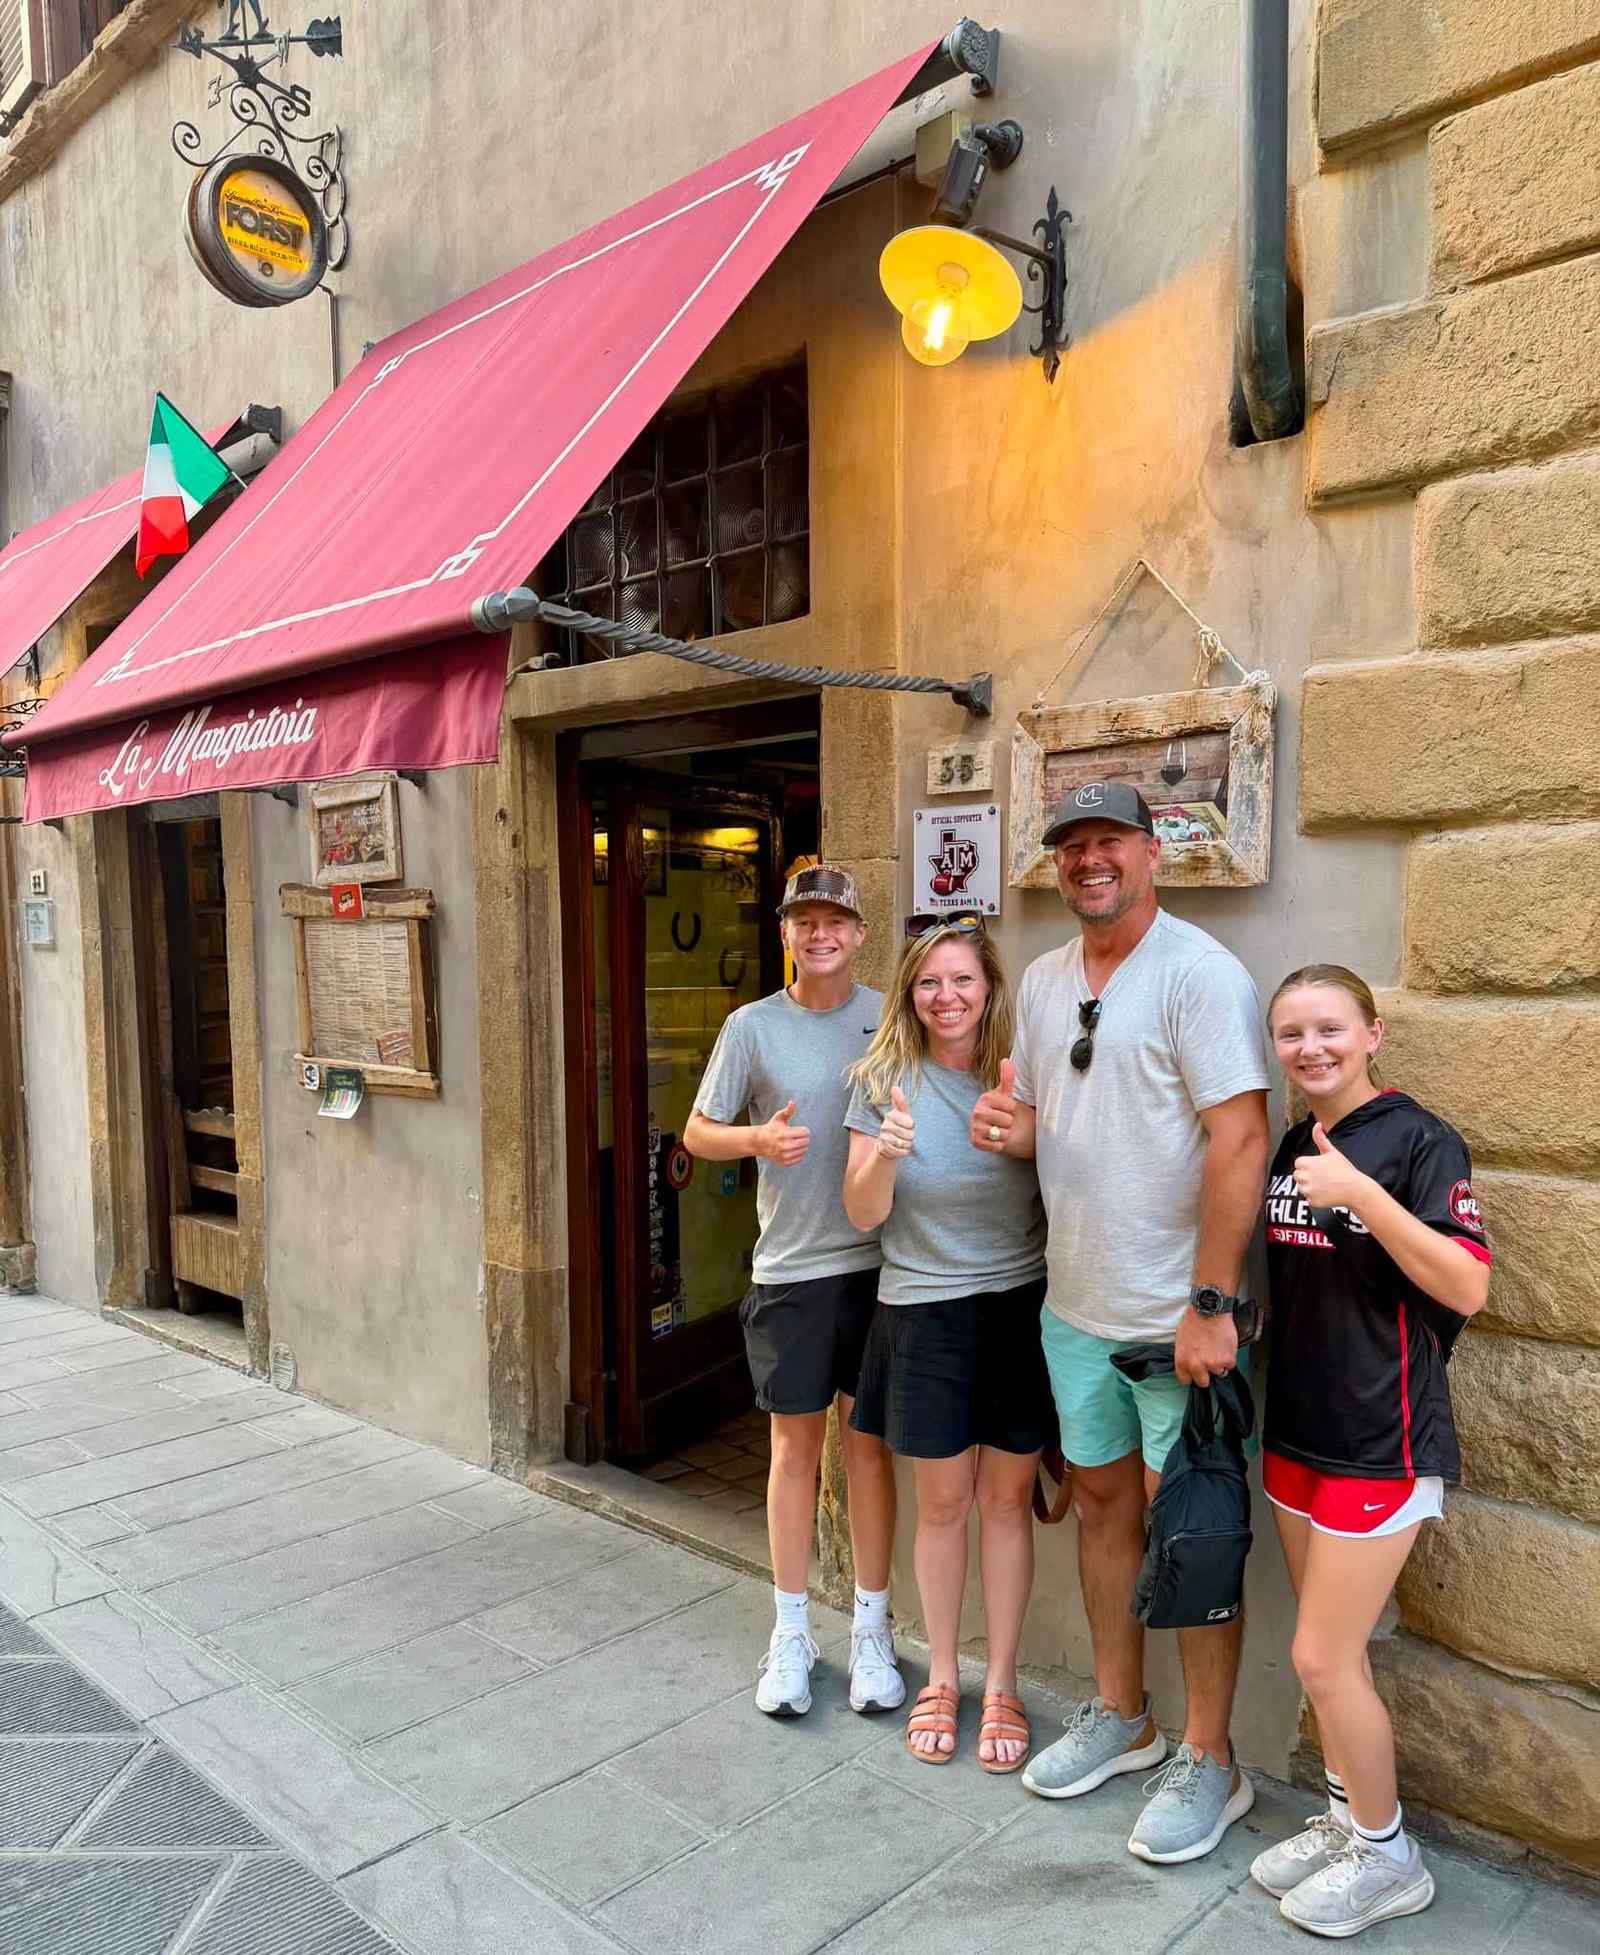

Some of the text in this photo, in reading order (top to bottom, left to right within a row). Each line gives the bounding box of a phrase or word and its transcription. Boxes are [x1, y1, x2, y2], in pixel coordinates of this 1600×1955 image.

[226, 201, 305, 249] FORST
[99, 697, 318, 796] La Mangiatoia
[931, 813, 982, 825] OFFICIAL SUPPORTER
[940, 899, 958, 907] TEXAS
